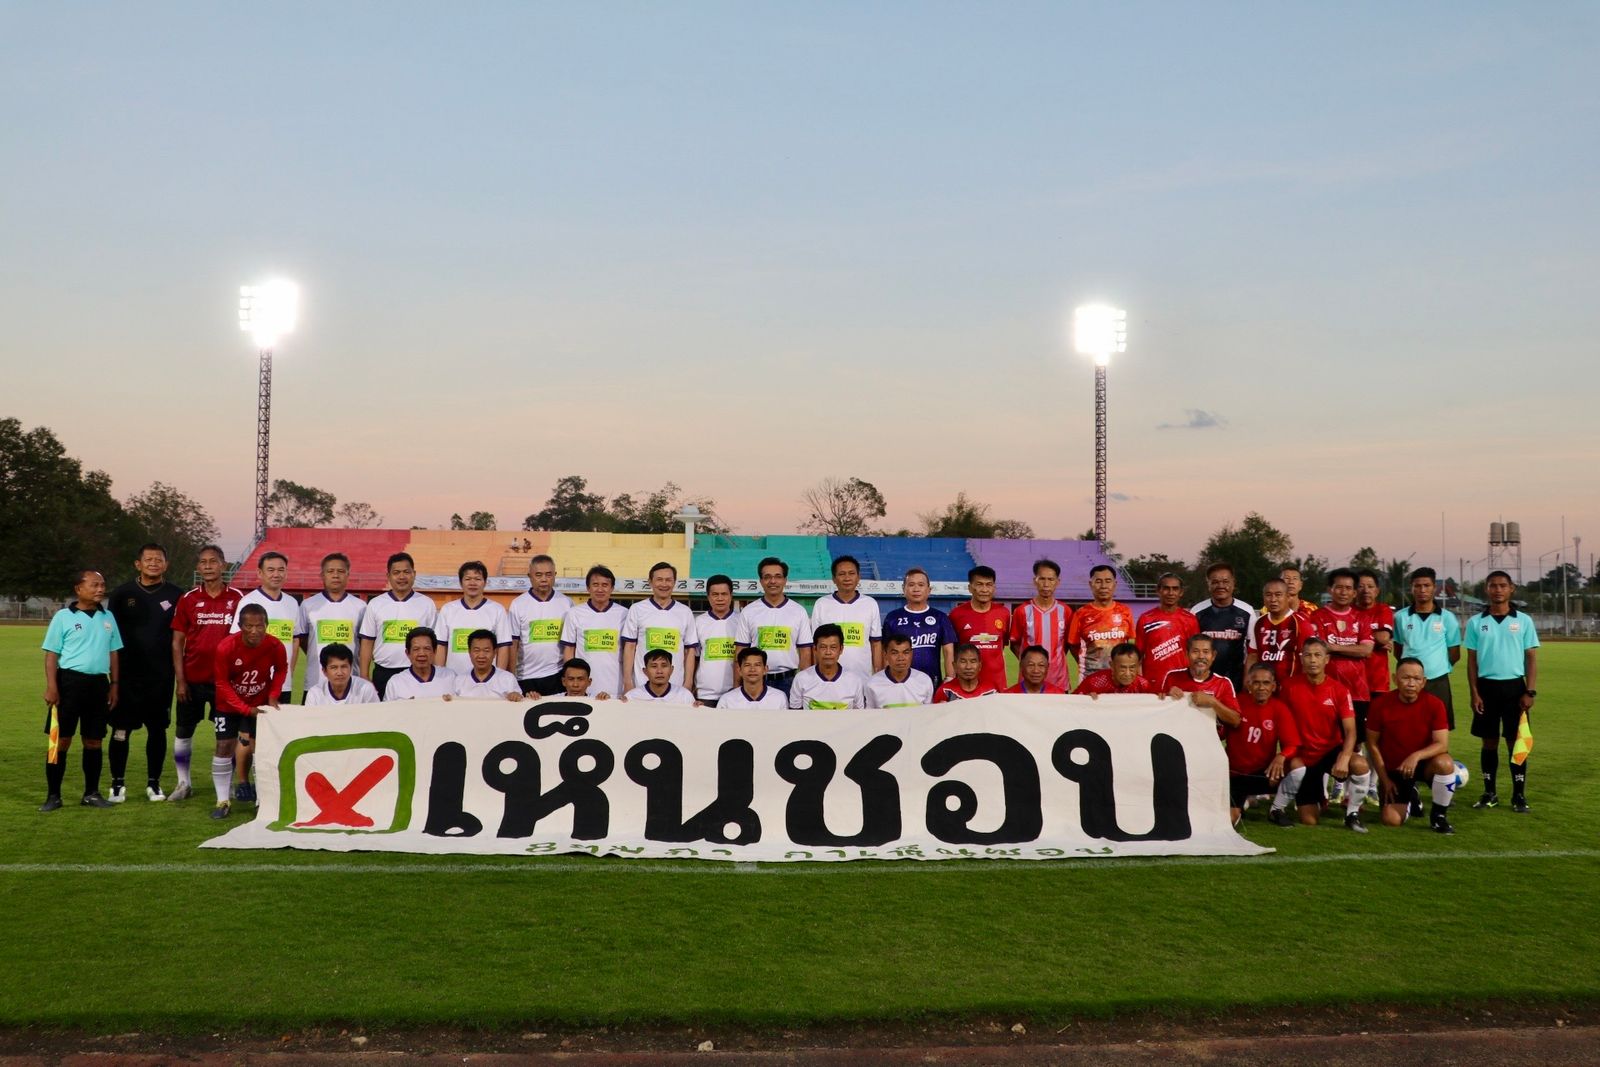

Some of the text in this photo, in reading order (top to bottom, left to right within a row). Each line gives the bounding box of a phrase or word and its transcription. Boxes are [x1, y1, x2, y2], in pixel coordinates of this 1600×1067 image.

[897, 617, 908, 626] 23
[775, 630, 787, 638] เห็น
[847, 627, 859, 635] เห็น
[1262, 630, 1277, 645] 23
[1153, 642, 1179, 661] CREAM
[1261, 651, 1285, 661] Gulf
[241, 670, 258, 684] 22
[1247, 726, 1261, 743] 19
[424, 701, 1192, 846] เห็นชอบ
[525, 842, 556, 853] 8
